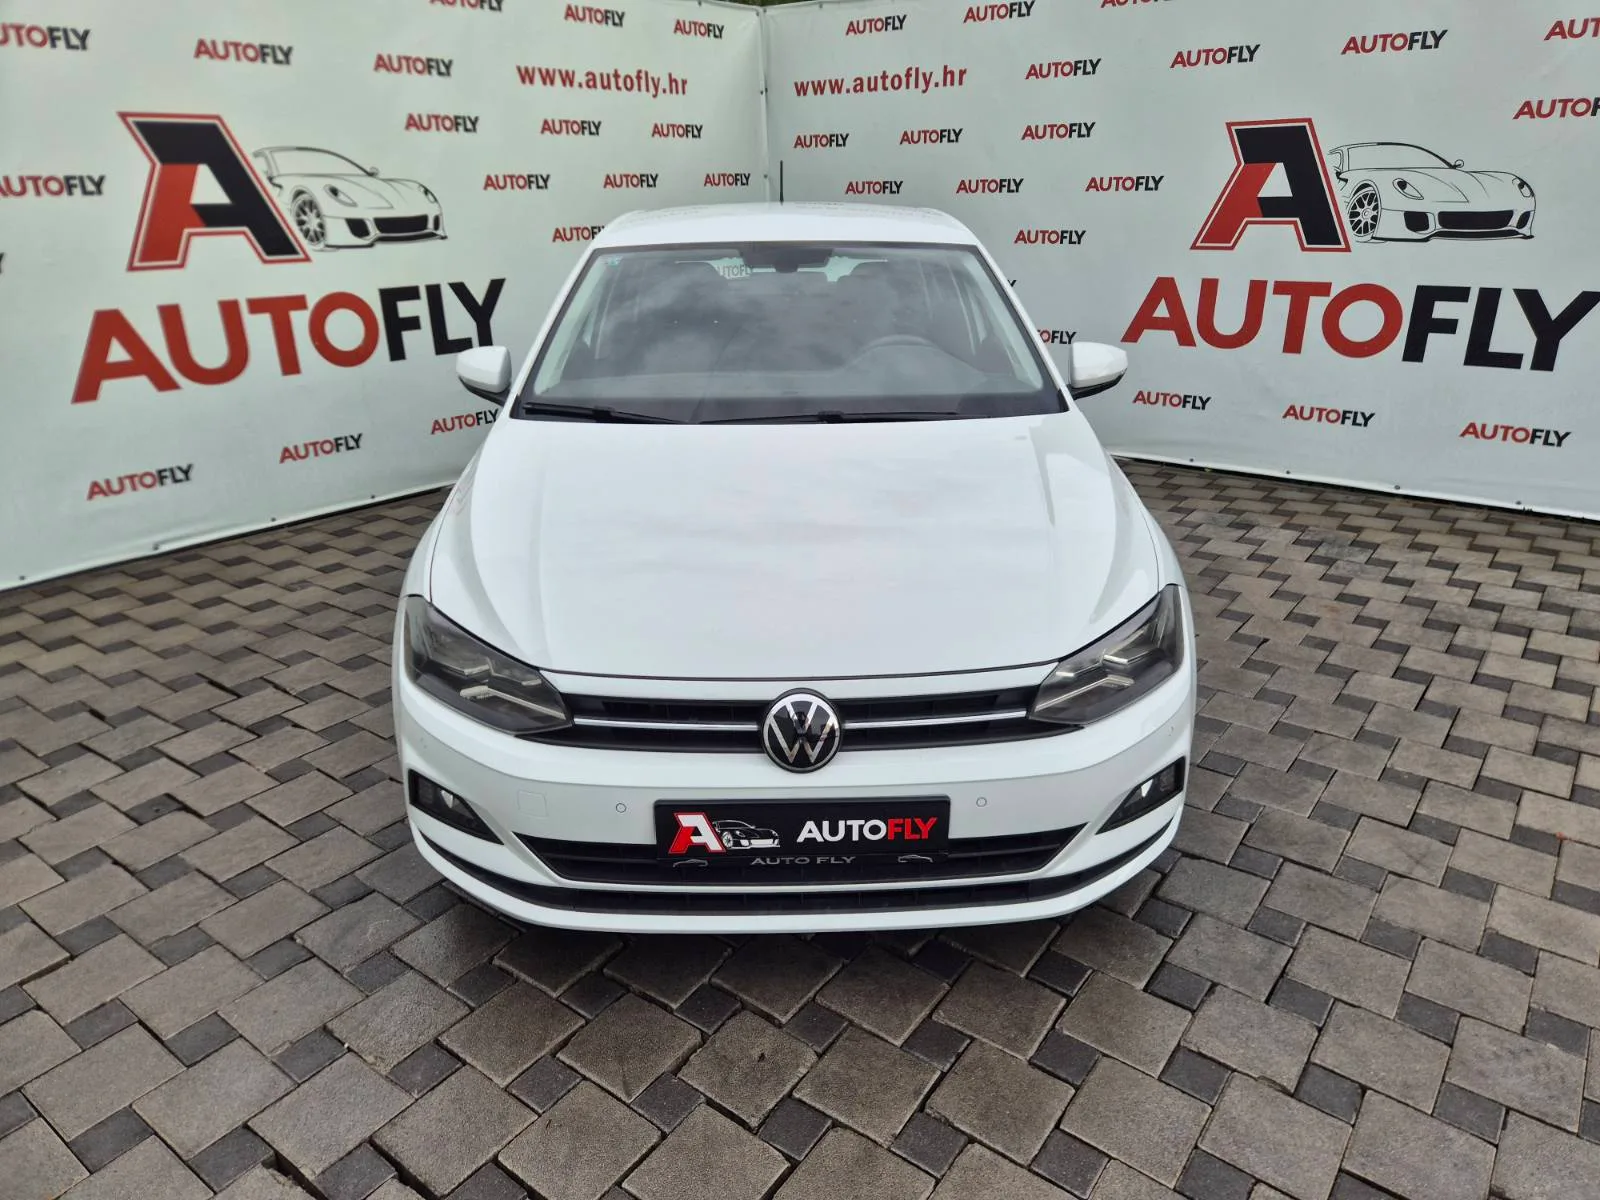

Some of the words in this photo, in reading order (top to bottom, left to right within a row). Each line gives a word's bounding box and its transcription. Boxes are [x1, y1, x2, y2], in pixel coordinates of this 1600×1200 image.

[564, 4, 625, 27] AUTOFLY
[964, 0, 1035, 23] AUTOFLY
[674, 20, 724, 39] AUTOFLY
[846, 15, 907, 35] AUTOFLY
[194, 39, 293, 65] AUTOFLY
[1341, 30, 1448, 55] AUTOFLY
[374, 54, 452, 77] AUTOFLY
[1170, 44, 1260, 68] AUTOFLY
[1026, 58, 1101, 79] AUTOFLY
[517, 66, 687, 98] www.autofly.hr
[794, 65, 966, 96] www.autofly.hr
[405, 114, 478, 132] AUTOFLY
[541, 119, 601, 136] AUTOFLY
[652, 124, 703, 138] AUTOFLY
[1022, 122, 1095, 140] AUTOFLY
[794, 133, 849, 148] AUTOFLY
[900, 128, 963, 144] AUTOFLY
[484, 174, 550, 190] AUTOFLY
[604, 174, 658, 188] AUTOFLY
[704, 173, 750, 186] AUTOFLY
[846, 181, 903, 194] AUTOFLY
[956, 179, 1024, 193] AUTOFLY
[1086, 176, 1164, 191] AUTOFLY
[1015, 230, 1086, 244] AUTOFLY
[1121, 276, 1600, 372] AUTOFLY
[72, 278, 506, 404] AUTOFLY
[1133, 391, 1211, 410] AUTOFLY
[431, 408, 499, 434] AUTOFLY
[1283, 405, 1375, 427] AUTOFLY
[1460, 423, 1571, 447] AUTOFLY
[280, 433, 362, 463] AUTOFLY
[88, 464, 193, 500] AUTOFLY
[797, 817, 938, 842] AUTOFLY
[750, 857, 810, 866] AUTO
[816, 856, 856, 866] FLY
